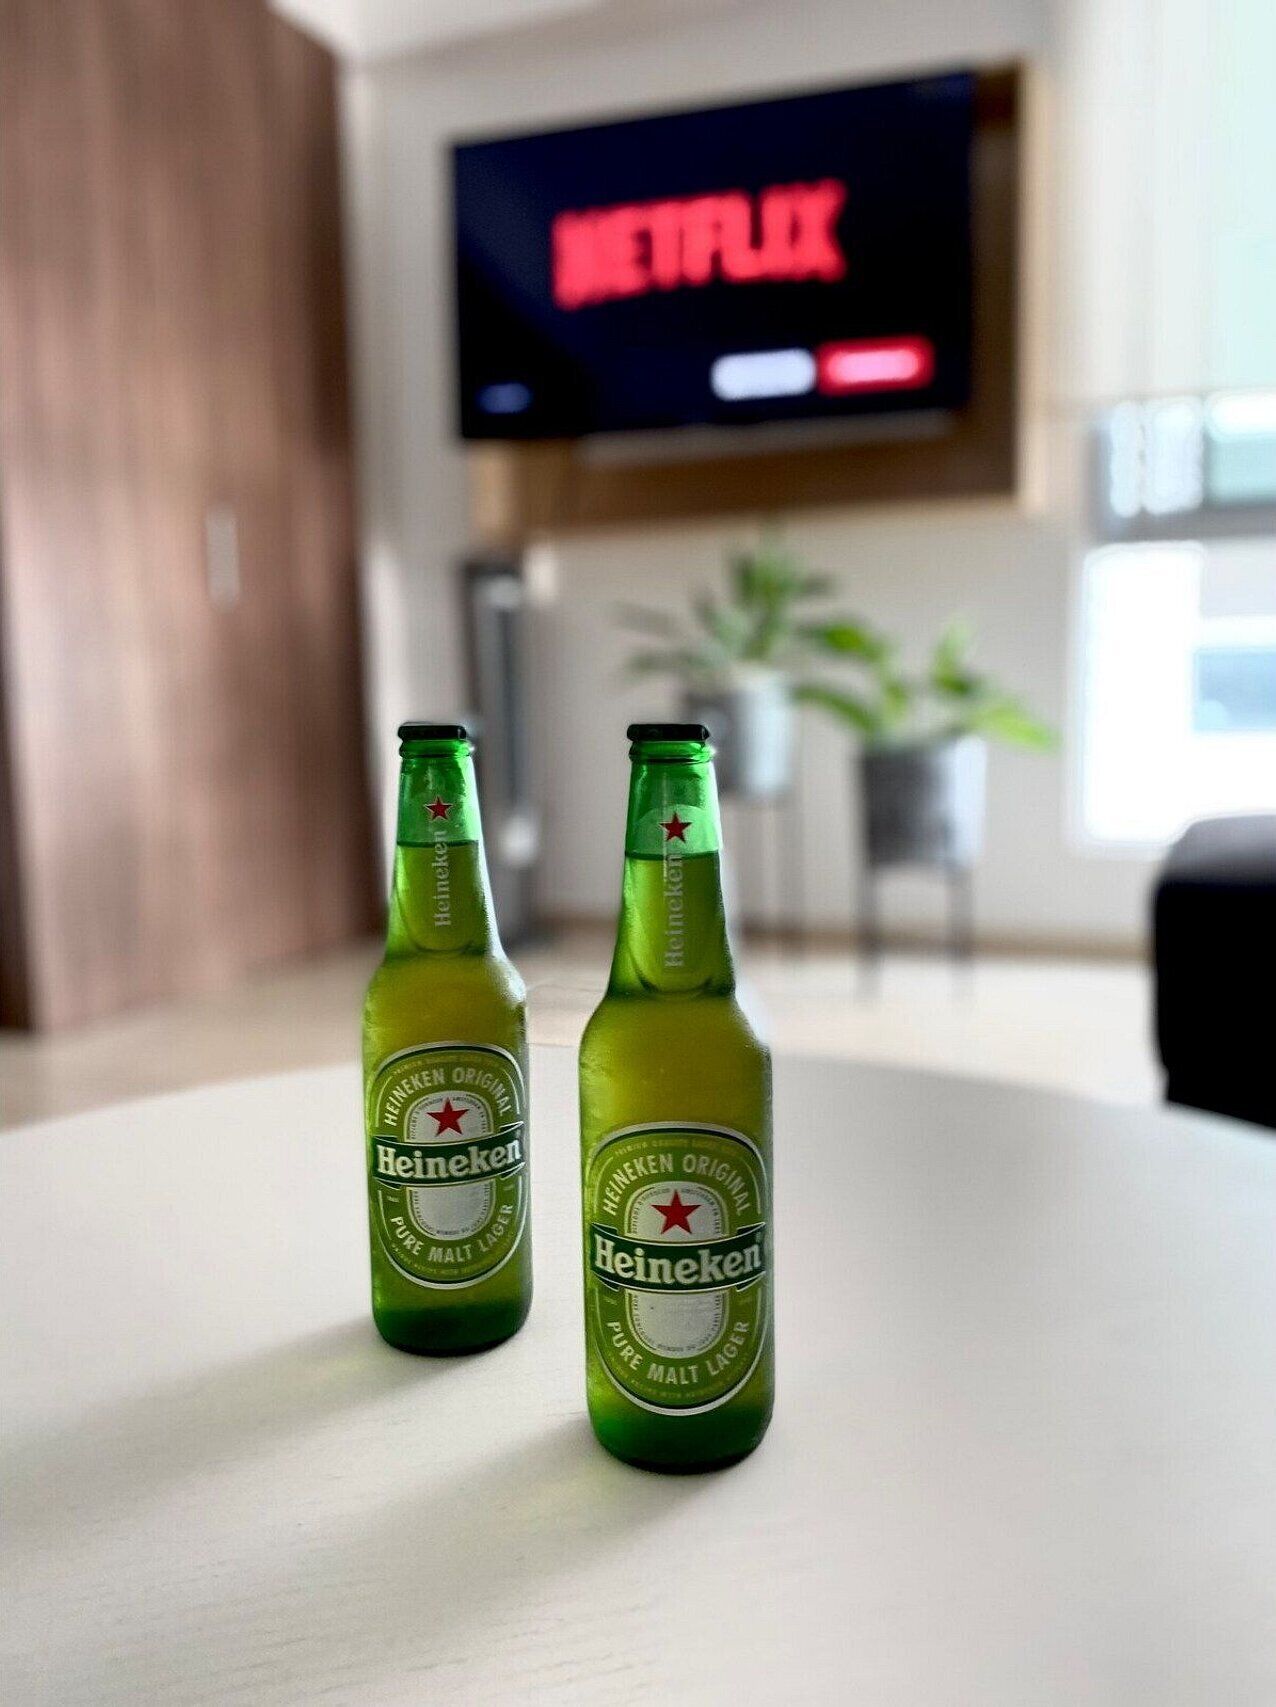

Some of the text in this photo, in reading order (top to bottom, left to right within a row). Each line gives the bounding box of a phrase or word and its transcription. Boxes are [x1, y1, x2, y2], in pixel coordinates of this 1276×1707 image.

[432, 829, 451, 929] Heineken
[664, 852, 685, 969] Heineken
[384, 1067, 445, 1127] HEINEKEN
[452, 1066, 514, 1117] ORIGINAL
[377, 1137, 521, 1181] Heineken
[602, 1153, 674, 1216] HEINEKEN
[682, 1153, 750, 1217] ORIGINAL
[390, 1216, 424, 1256] PURE
[428, 1244, 473, 1264] MALT
[478, 1204, 514, 1253] LAGER
[594, 1233, 762, 1285] Heineken
[607, 1321, 643, 1371] PURE
[647, 1363, 699, 1385] MALT
[706, 1321, 750, 1376] LAGER
